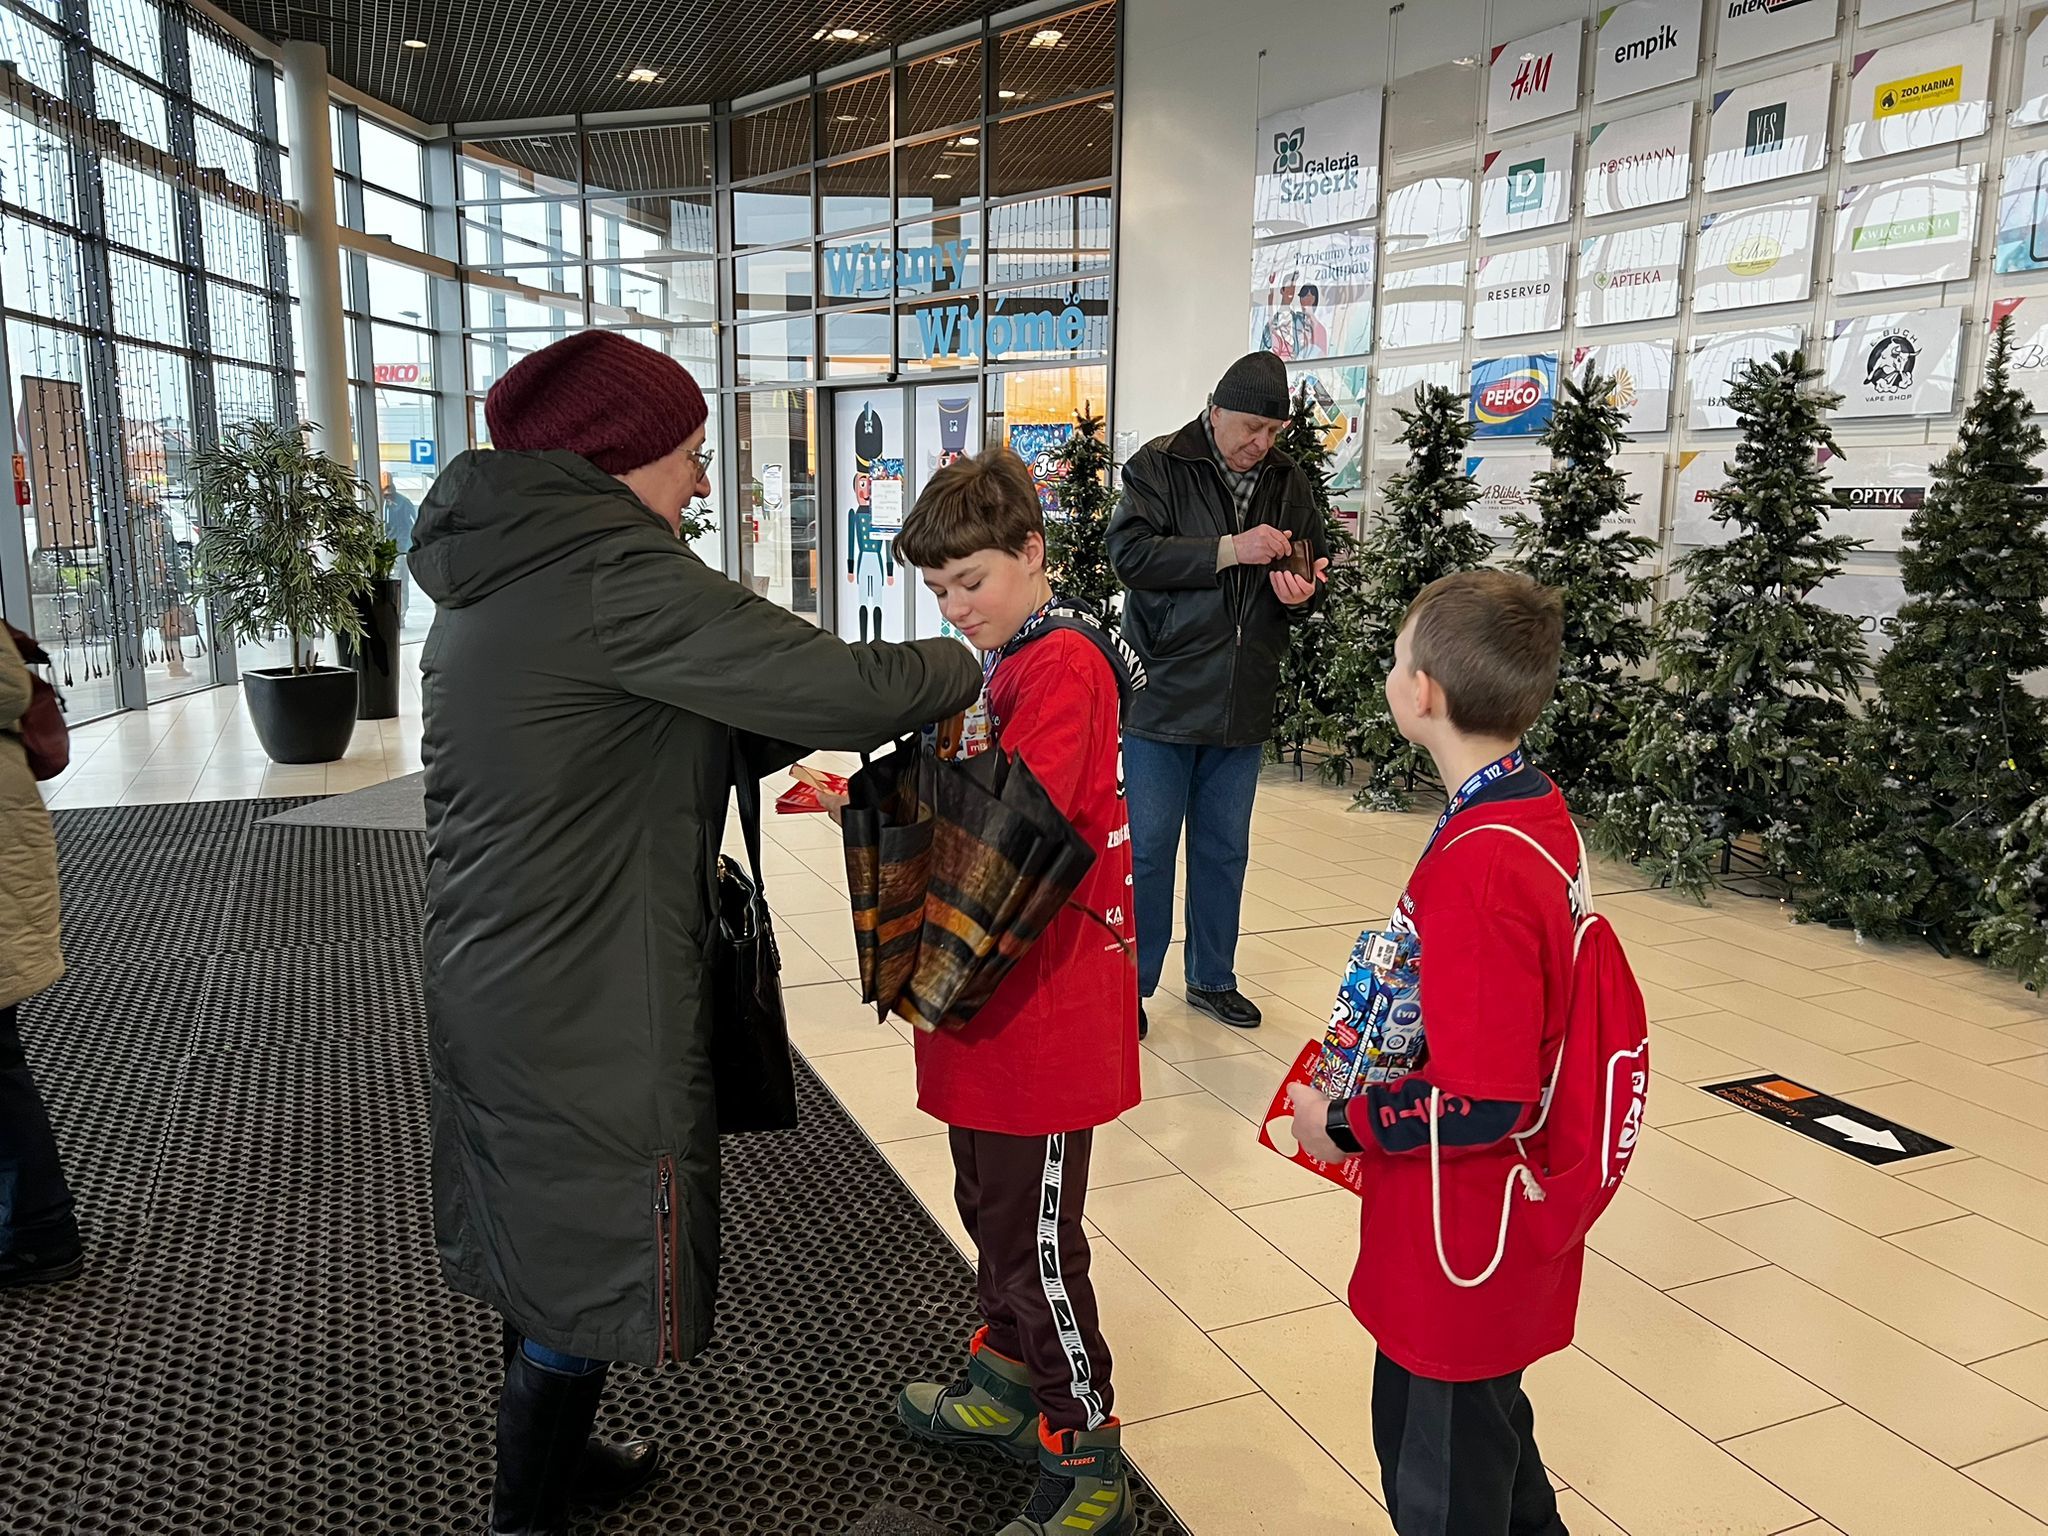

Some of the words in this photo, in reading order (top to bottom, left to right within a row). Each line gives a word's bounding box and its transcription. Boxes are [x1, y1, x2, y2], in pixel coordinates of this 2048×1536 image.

[1614, 25, 1678, 63] empik
[1510, 53, 1553, 101] H&M
[1901, 86, 1919, 98] ZOO
[1921, 77, 1954, 93] KARINA
[1756, 112, 1777, 146] YES
[1304, 152, 1359, 177] Galeria
[1600, 146, 1676, 175] ROSSMANN
[1280, 170, 1359, 204] Szperk
[1348, 243, 1370, 257] czas
[824, 237, 972, 295] Witamy
[1314, 259, 1370, 281] zakupów
[1610, 269, 1661, 289] APTEKA
[1488, 283, 1551, 302] RESERVED
[1485, 387, 1537, 406] PEPCO
[415, 442, 432, 462] P
[1850, 488, 1905, 504] OPTYK
[1483, 764, 1503, 780] 112
[1396, 1009, 1417, 1019] tvn
[1044, 1159, 1062, 1188] NIKE
[1040, 1217, 1058, 1246] NIKE
[1069, 1456, 1096, 1467] TERREX
